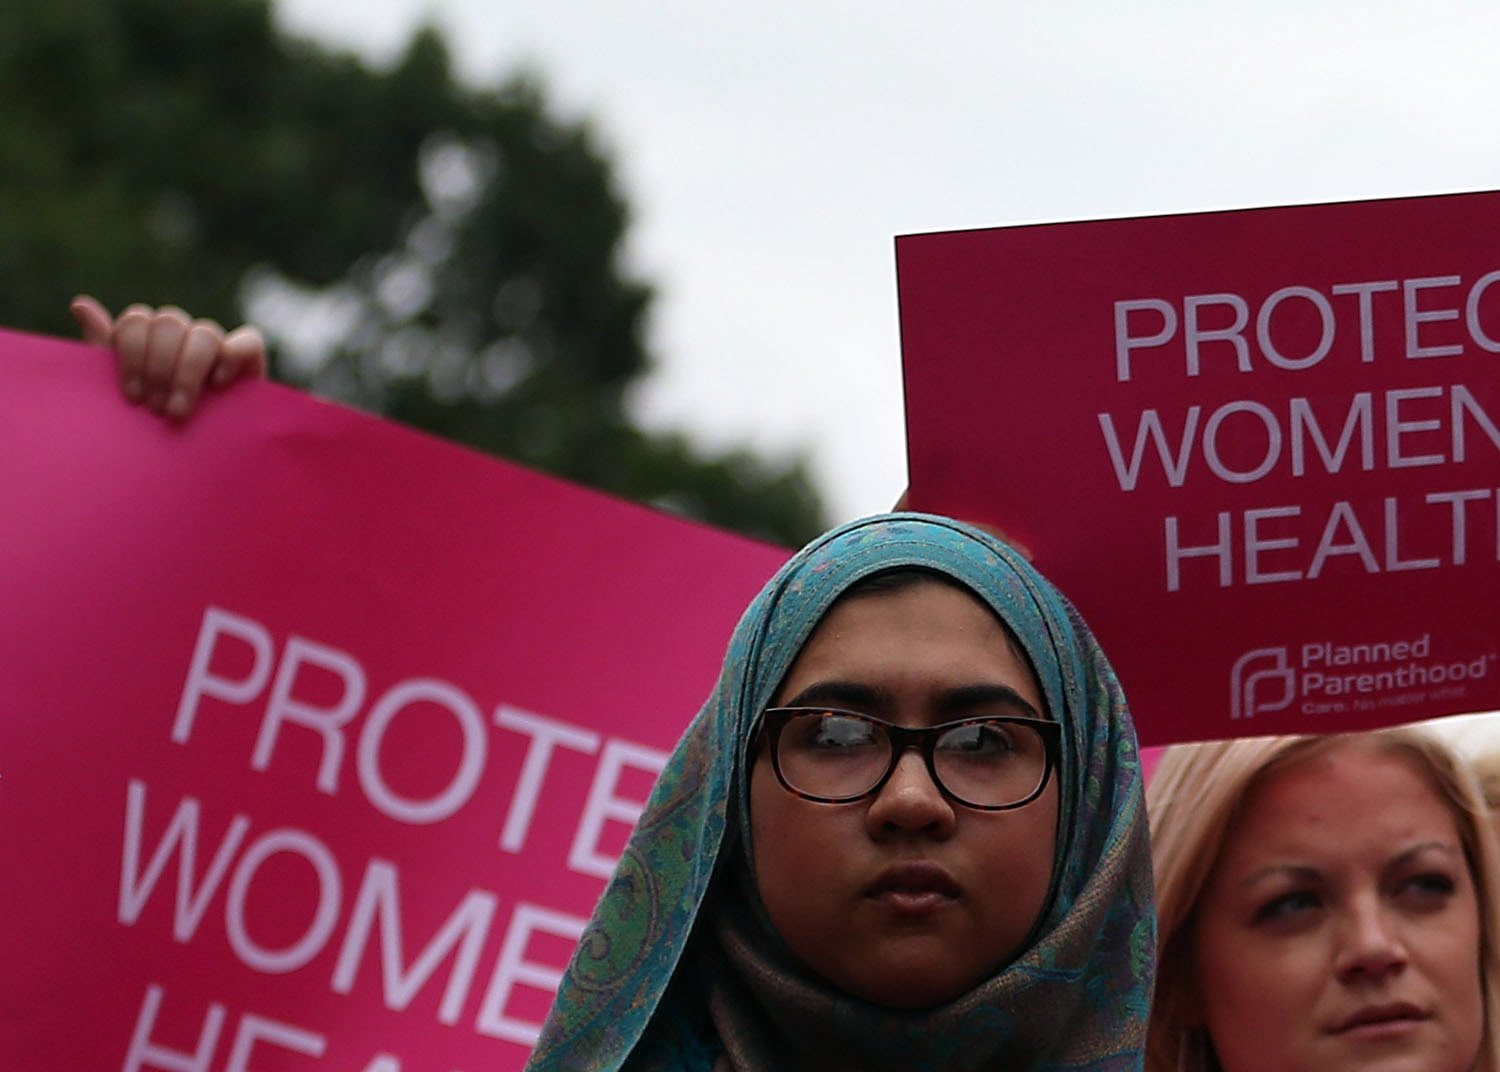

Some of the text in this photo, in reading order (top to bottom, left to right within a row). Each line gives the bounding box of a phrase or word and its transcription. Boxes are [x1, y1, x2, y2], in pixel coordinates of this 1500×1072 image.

[171, 607, 668, 878] PROTE
[1302, 633, 1430, 668] Planned
[118, 780, 595, 1046] WOME
